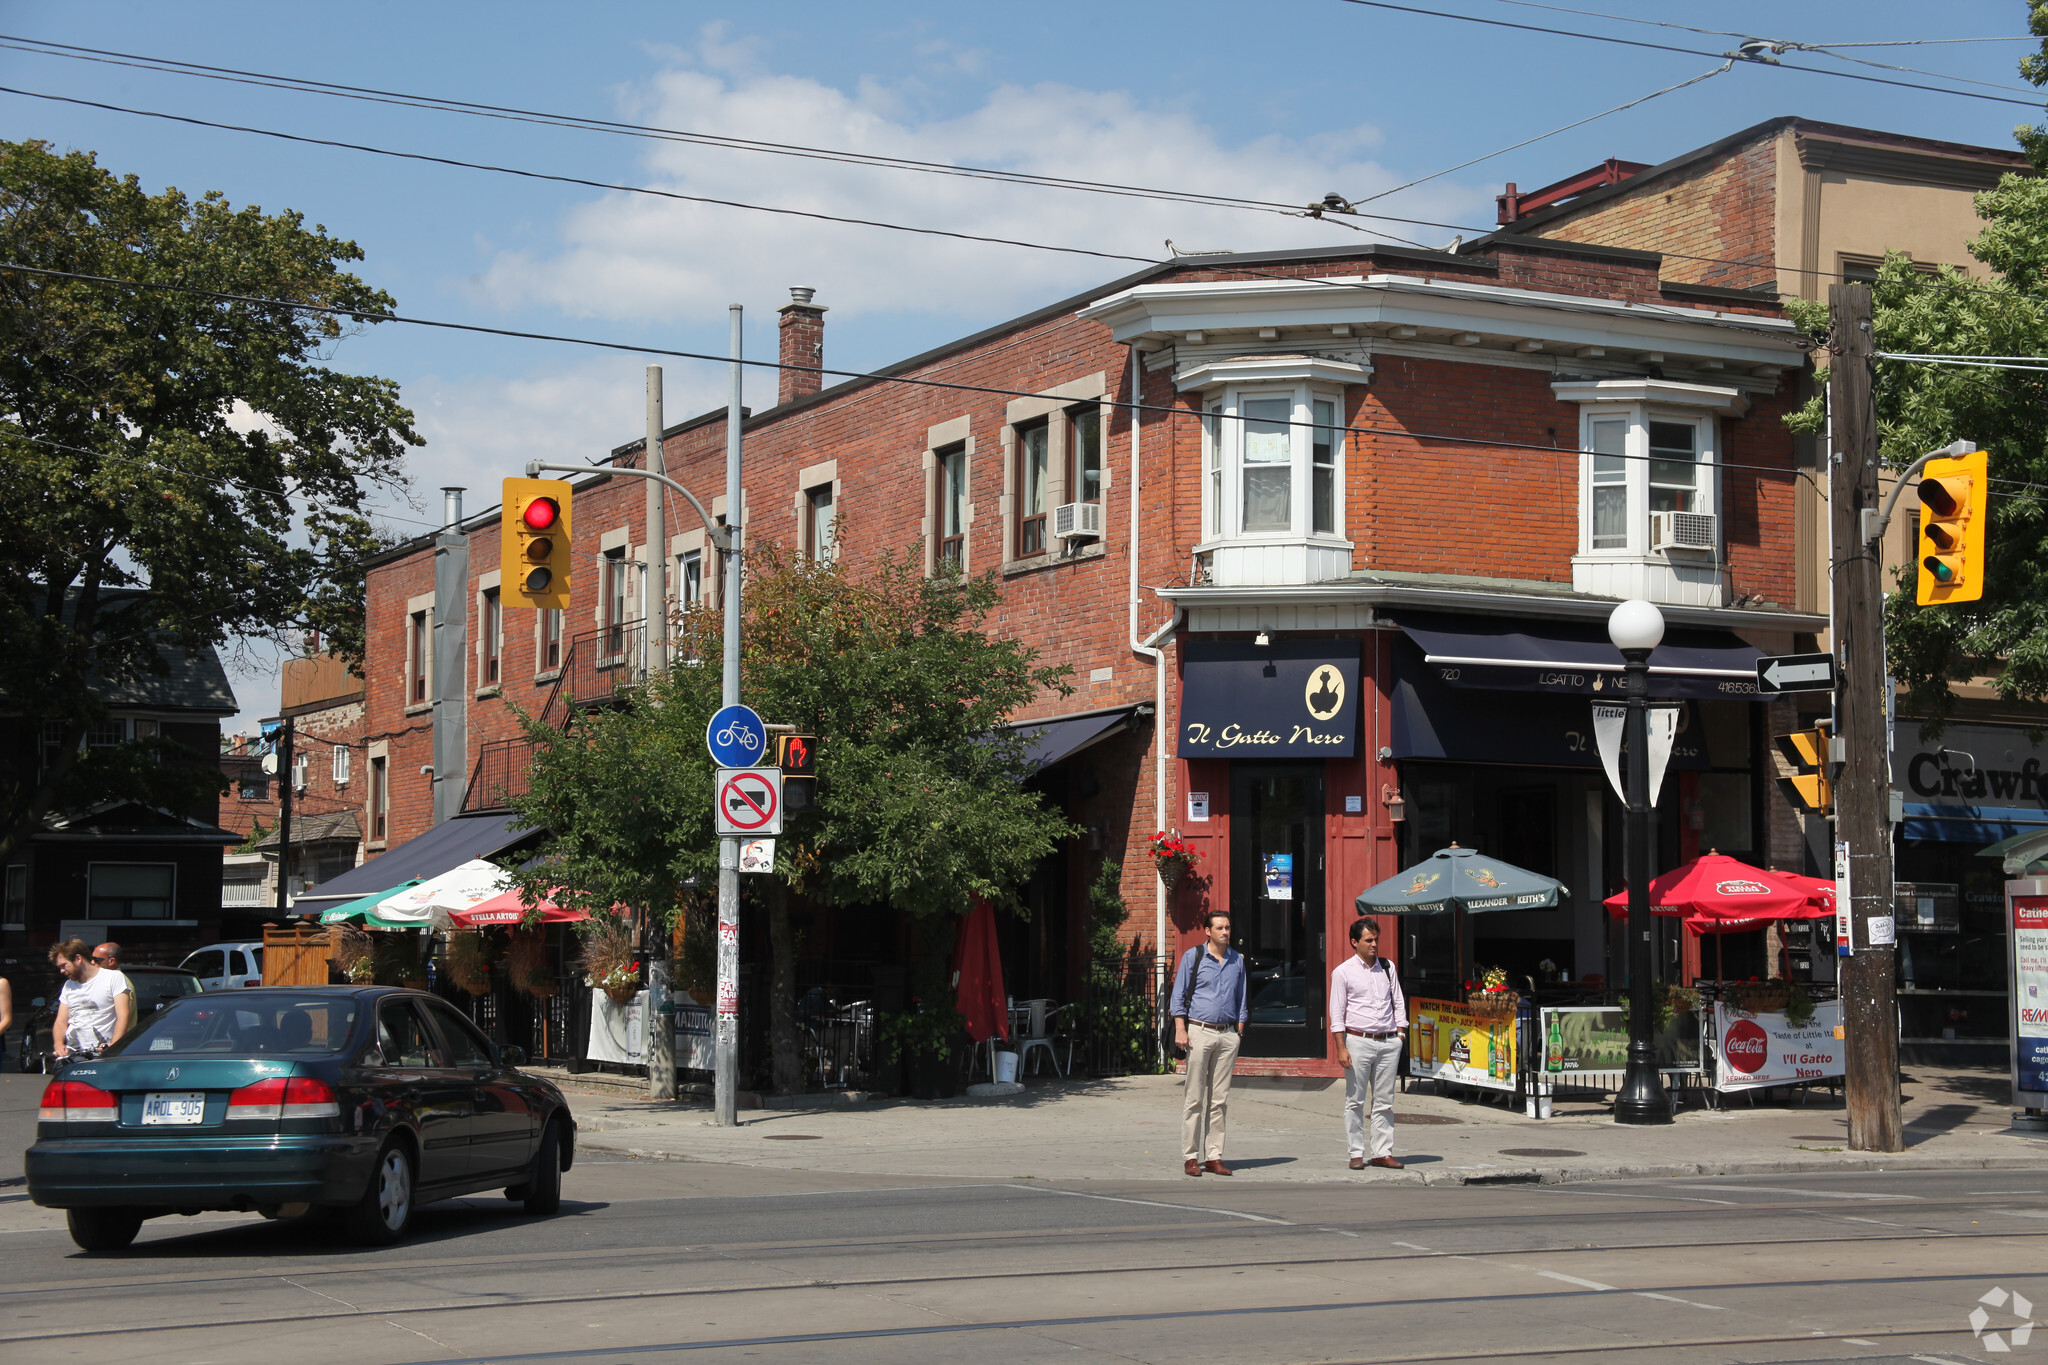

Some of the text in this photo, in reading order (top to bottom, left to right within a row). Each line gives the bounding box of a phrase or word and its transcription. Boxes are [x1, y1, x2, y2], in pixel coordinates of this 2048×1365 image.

[1440, 668, 1461, 681] 720
[1596, 708, 1625, 718] little
[1187, 723, 1345, 749] Il Gatto Nero
[1417, 902, 1444, 911] KEITH'S
[1467, 893, 1546, 909] ALEXANDER KEITH'S
[471, 912, 519, 921] STELLA ARTOIS
[1420, 1001, 1440, 1012] WATCH
[1441, 1003, 1452, 1013] THE
[1438, 1014, 1450, 1024] JUNE
[1460, 1017, 1473, 1027] JULY
[1809, 1020, 1822, 1028] the
[1773, 1032, 1792, 1040] Taste
[1793, 1031, 1801, 1039] of
[1802, 1031, 1823, 1039] Little
[1783, 1054, 1833, 1065] I'll Gatto
[1795, 1068, 1823, 1078] Nero
[180, 1100, 202, 1116] 905
